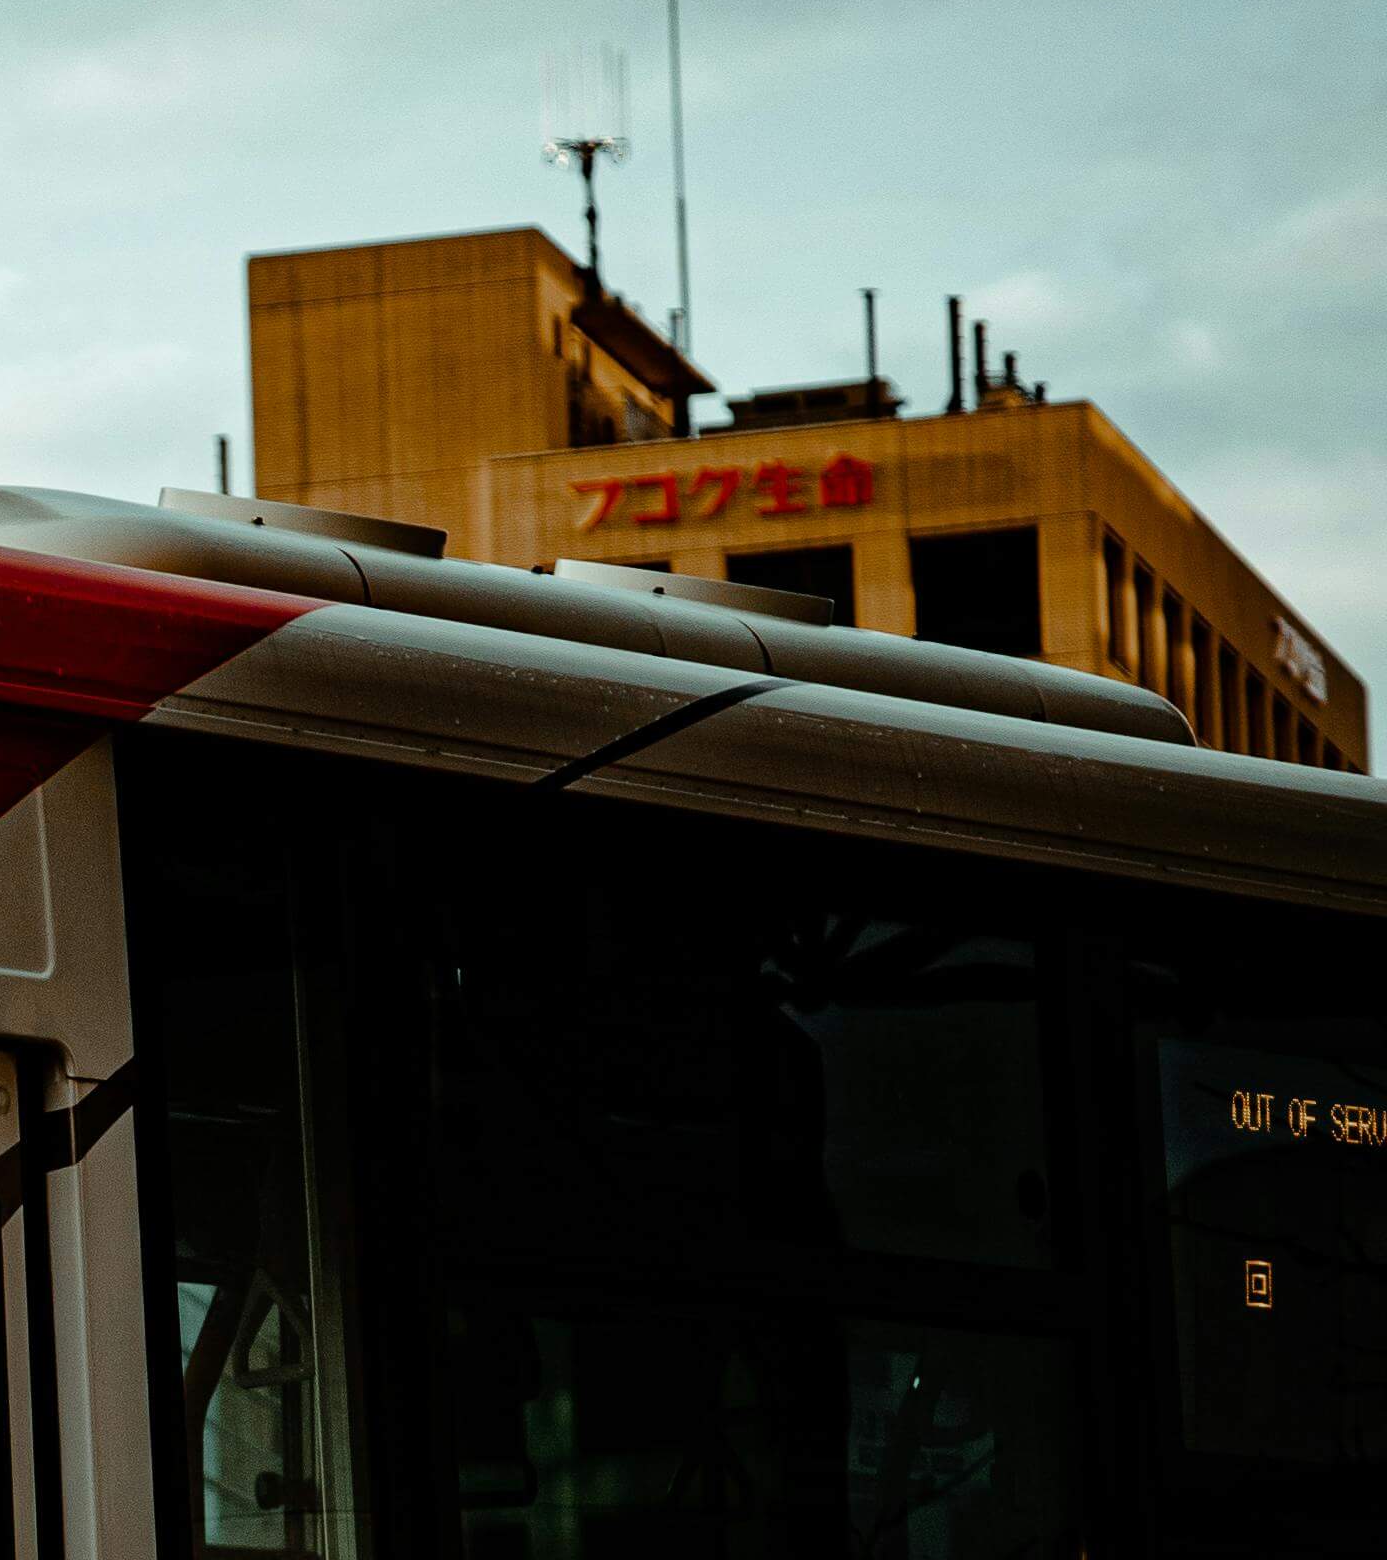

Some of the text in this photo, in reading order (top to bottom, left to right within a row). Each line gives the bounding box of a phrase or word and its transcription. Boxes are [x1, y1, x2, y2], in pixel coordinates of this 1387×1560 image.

[569, 452, 874, 534] フコク生命
[1230, 1089, 1275, 1134] OUT
[1287, 1096, 1318, 1138] OF
[1244, 1258, 1274, 1310] 回
